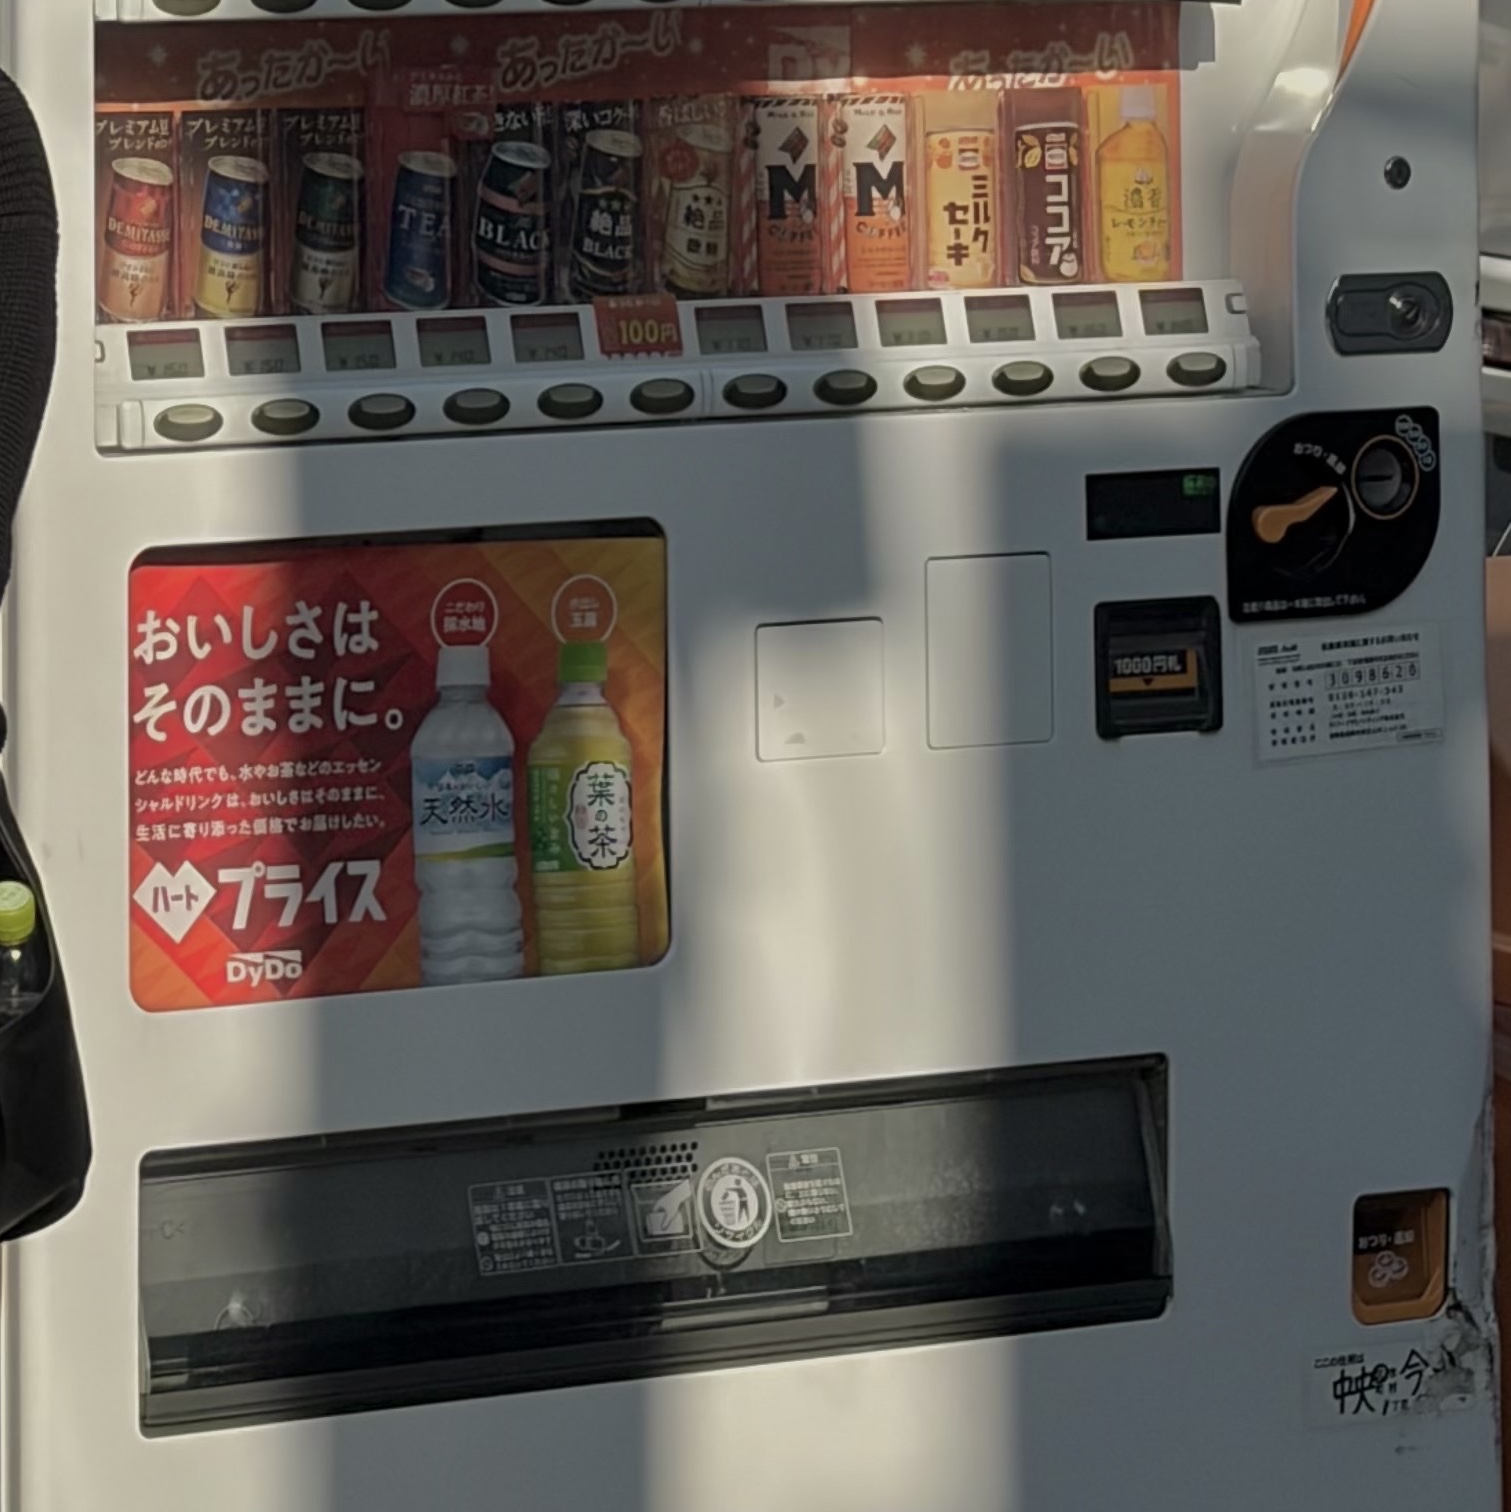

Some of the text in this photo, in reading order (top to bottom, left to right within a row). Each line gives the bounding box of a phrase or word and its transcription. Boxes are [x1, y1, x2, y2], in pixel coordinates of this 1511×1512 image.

[943, 201, 969, 266] セーキ
[972, 174, 991, 253] ミルク
[1045, 175, 1070, 266] ココア
[619, 319, 677, 345] 100円
[133, 600, 380, 666] おいしさは
[1114, 654, 1182, 675] 1000円札
[133, 675, 404, 742] そのままに。
[420, 794, 509, 826] 天然水
[587, 772, 617, 859] 葉の茶
[152, 859, 388, 931] ハート プライス
[226, 950, 303, 987] DyDo
